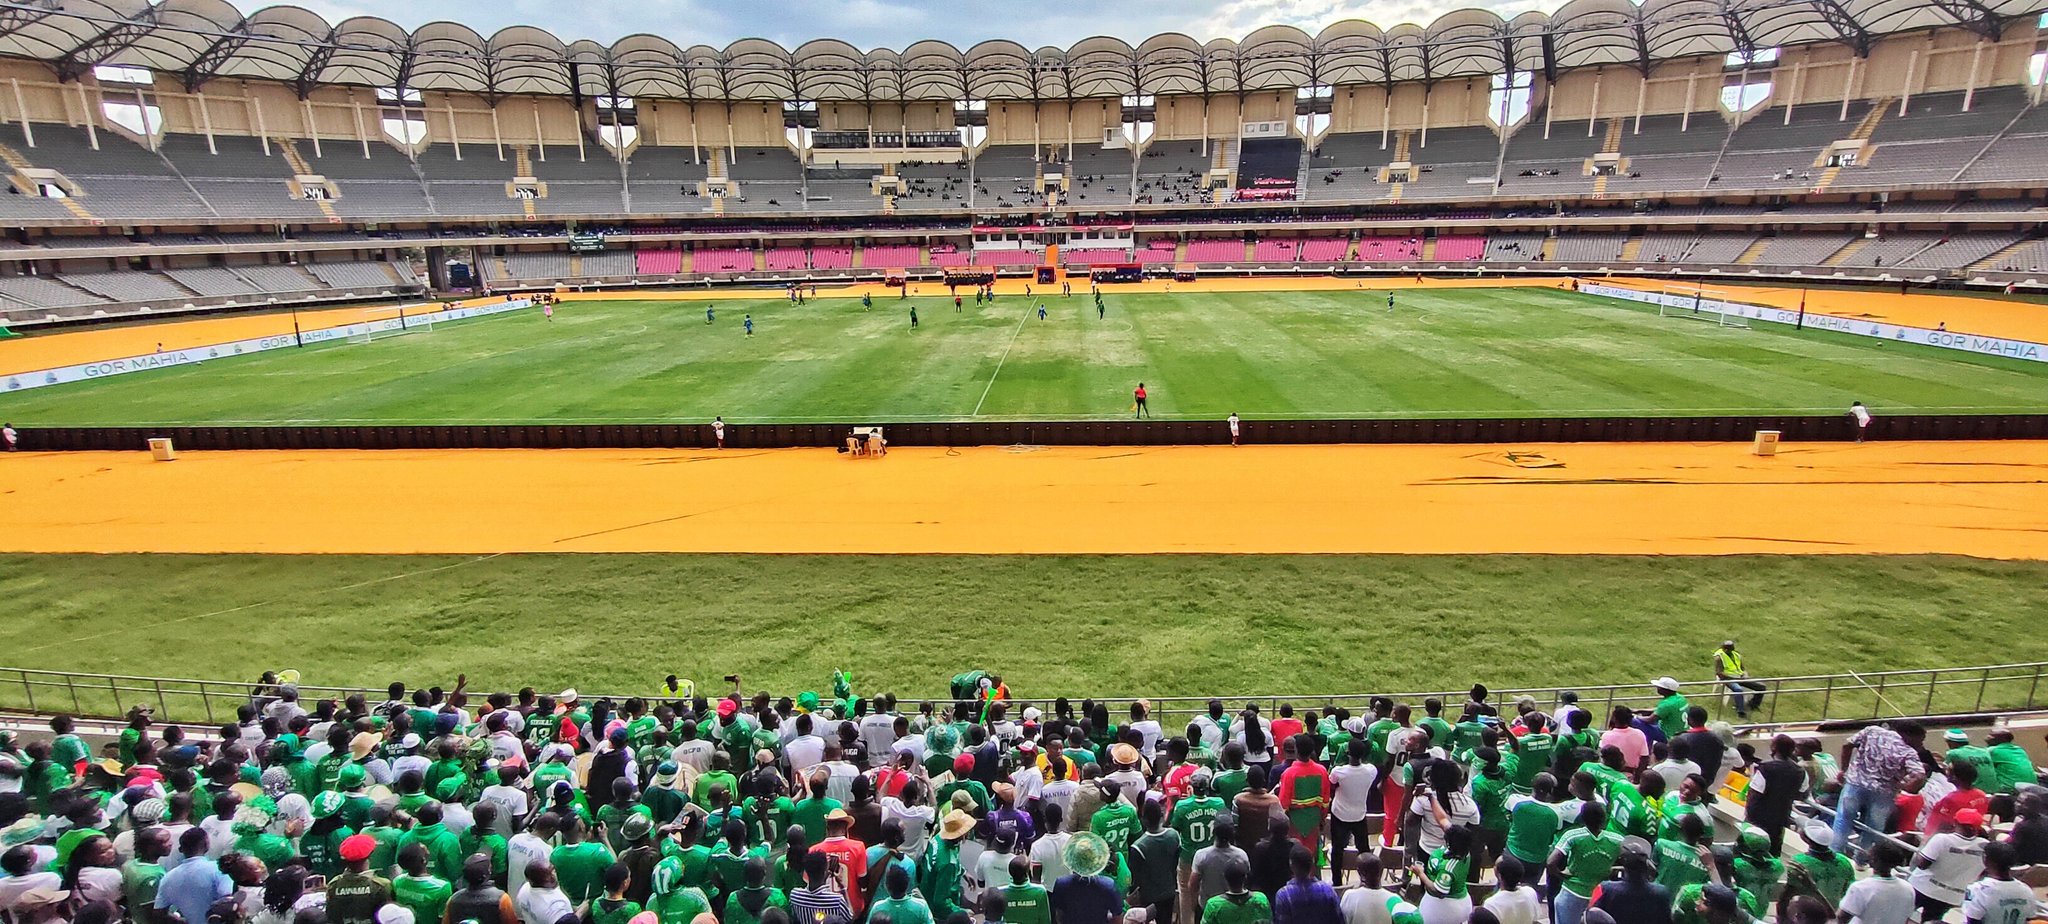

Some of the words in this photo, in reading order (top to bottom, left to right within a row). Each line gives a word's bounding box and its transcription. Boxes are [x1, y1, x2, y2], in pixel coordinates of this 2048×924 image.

[1672, 297, 1691, 307] GOR
[474, 307, 491, 315] GOR
[384, 320, 402, 329] GOR
[1807, 316, 1851, 331] MAHIA
[260, 337, 289, 349] GOR
[1927, 332, 1966, 347] GOR
[1972, 339, 2039, 358] MAHIA
[85, 361, 125, 376] GOR
[131, 352, 189, 372] MAHIA
